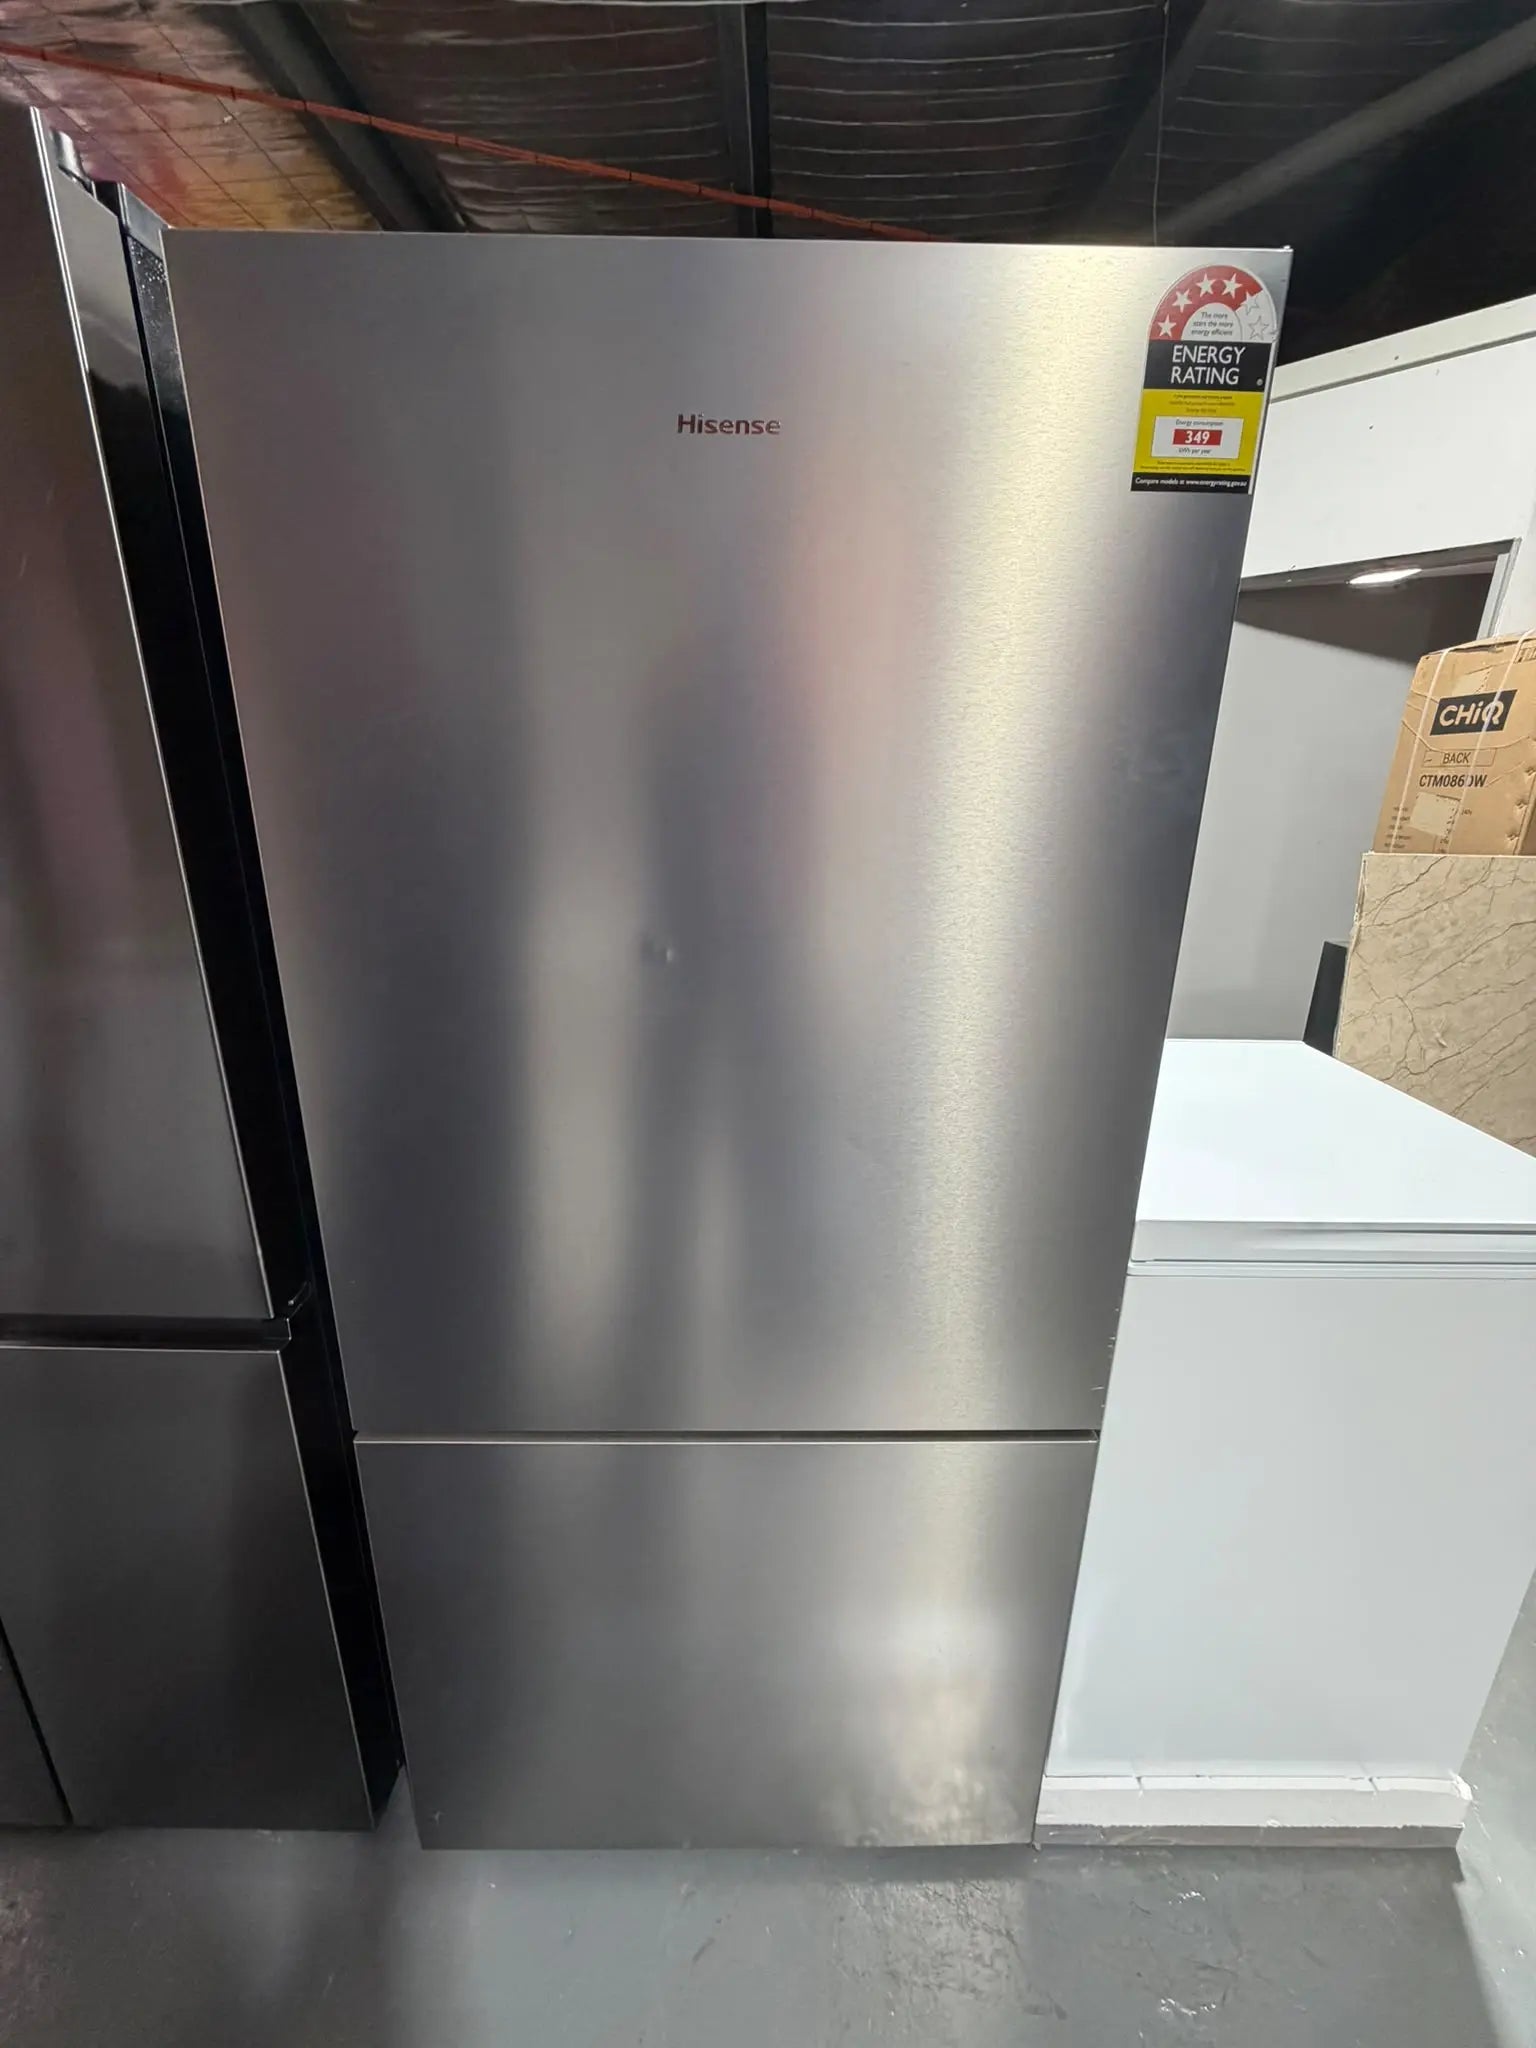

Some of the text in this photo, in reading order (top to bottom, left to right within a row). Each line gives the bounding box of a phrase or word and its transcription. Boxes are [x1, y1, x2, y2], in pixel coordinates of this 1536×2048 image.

[1172, 344, 1246, 365] ENERGY
[1170, 366, 1240, 385] RATING
[677, 413, 781, 435] Hisense
[1185, 430, 1210, 444] 349
[1439, 700, 1504, 727] CHiQ
[1442, 752, 1472, 764] BACK
